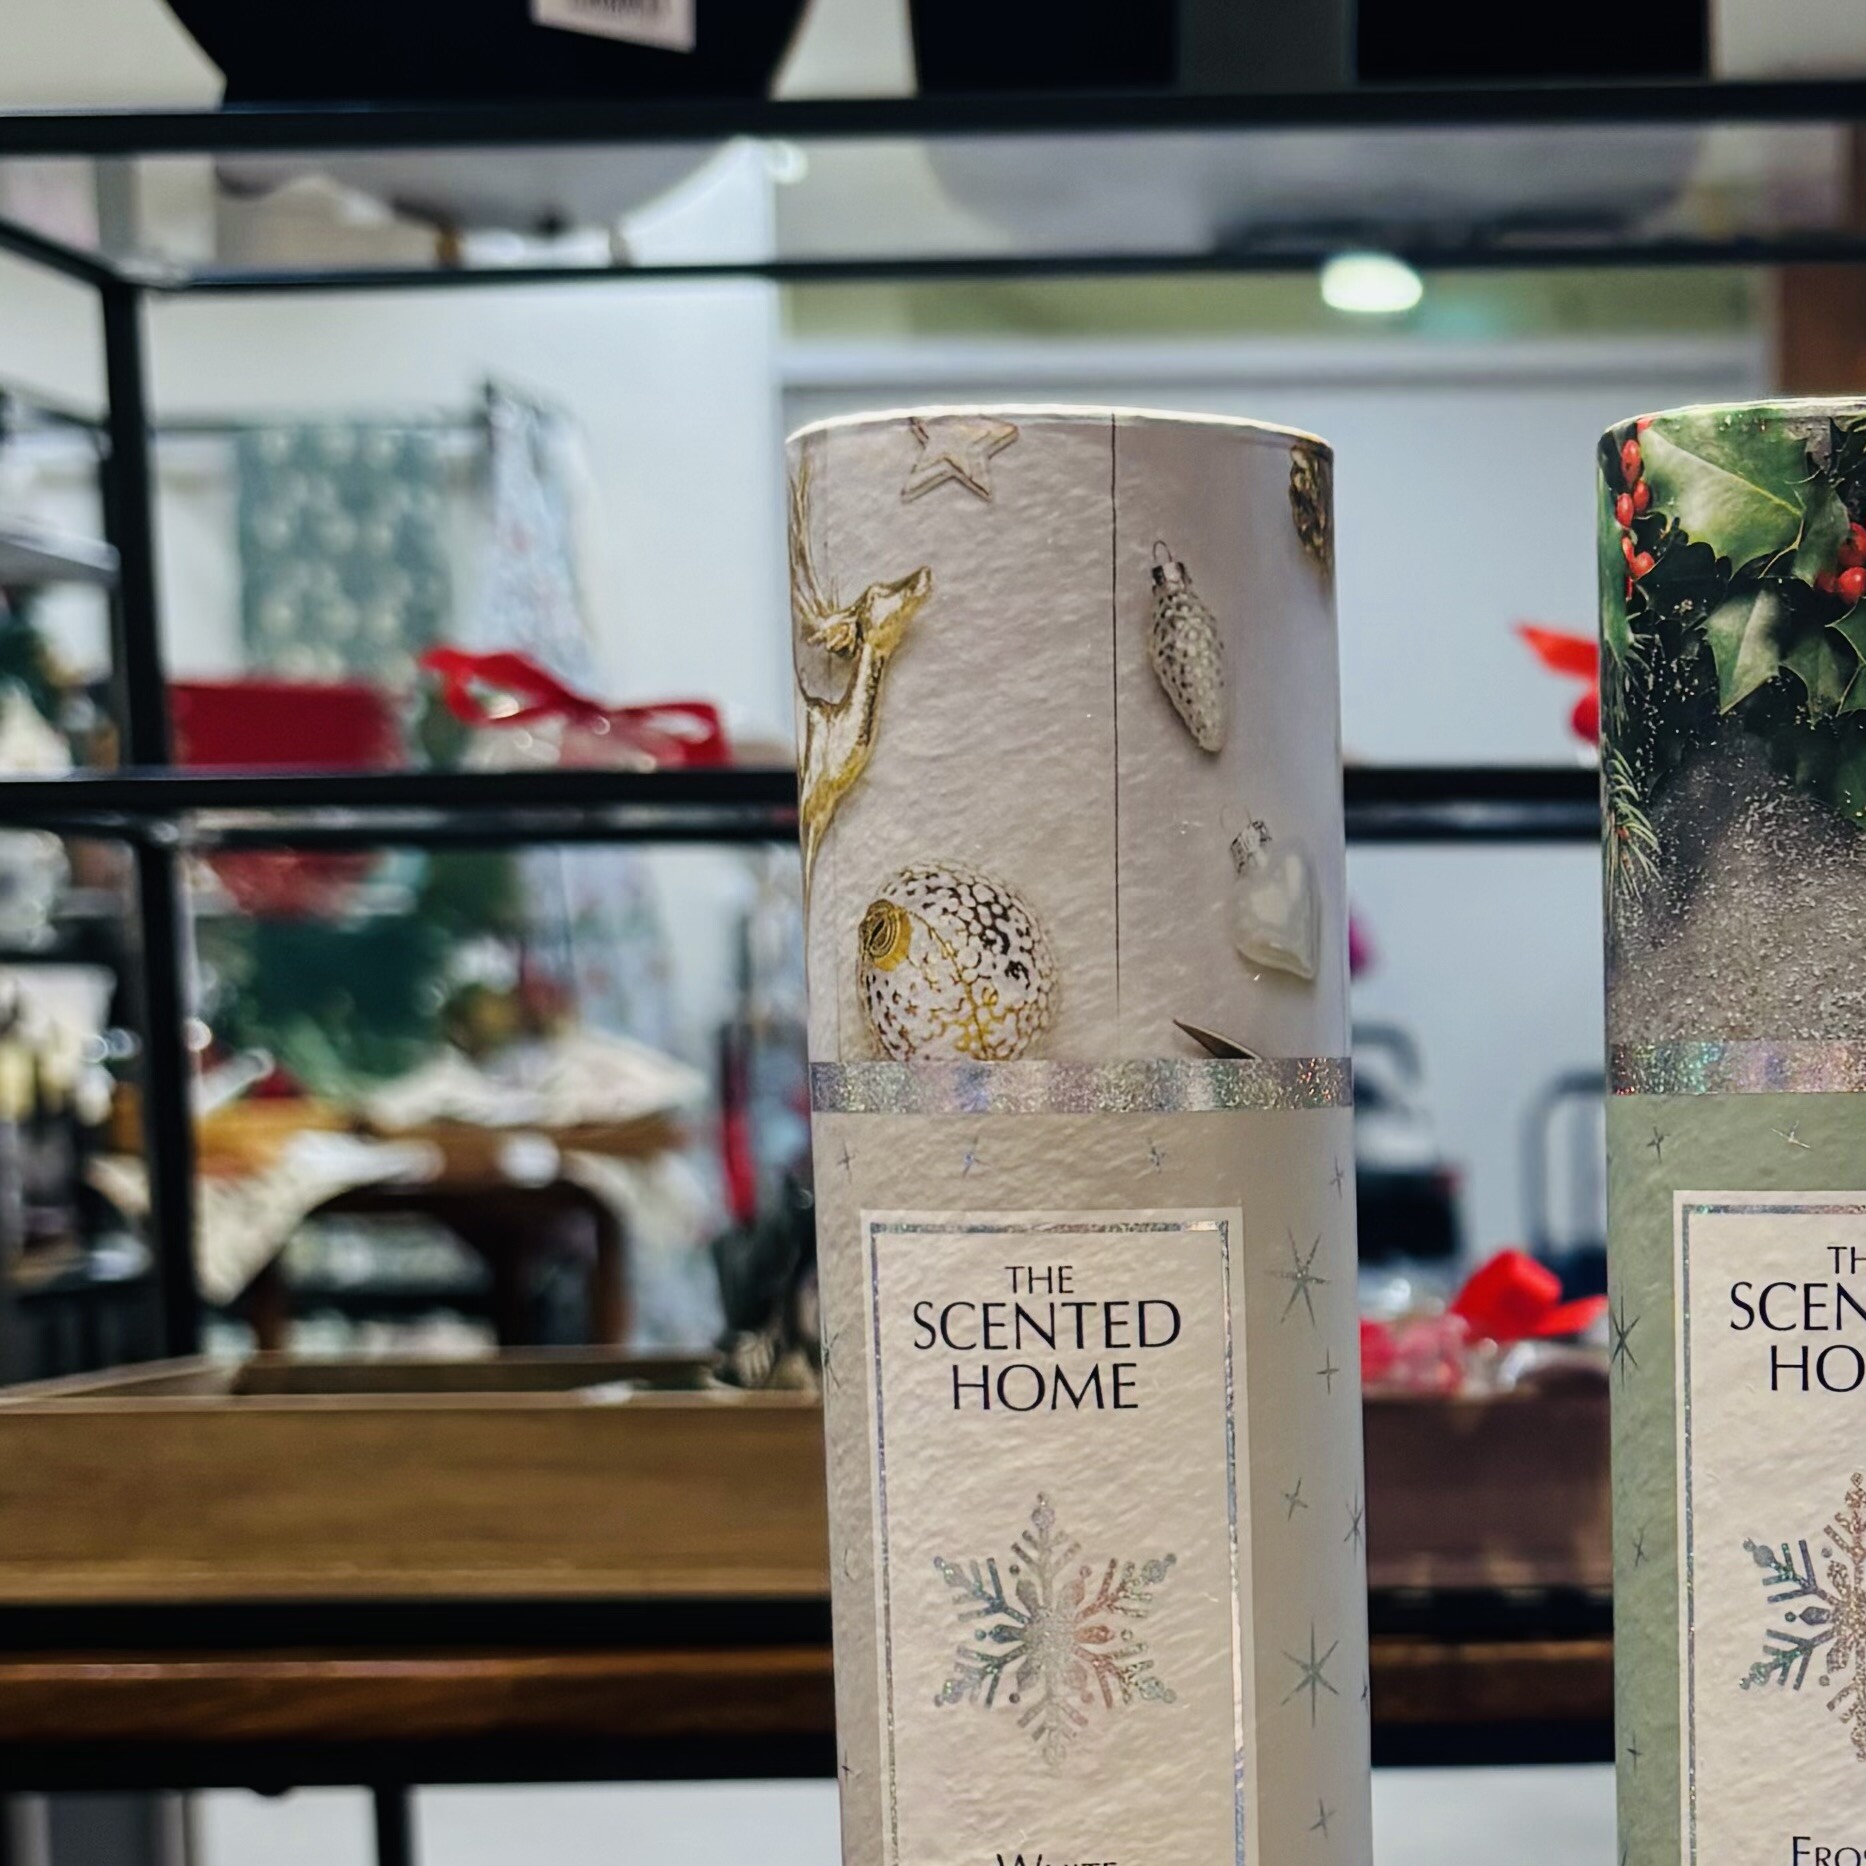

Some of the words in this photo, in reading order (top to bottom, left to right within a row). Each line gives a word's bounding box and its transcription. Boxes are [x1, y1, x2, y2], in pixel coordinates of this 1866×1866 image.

[1004, 1265, 1075, 1295] THE
[913, 1299, 1182, 1351] SCENTED
[952, 1362, 1139, 1412] HOME
